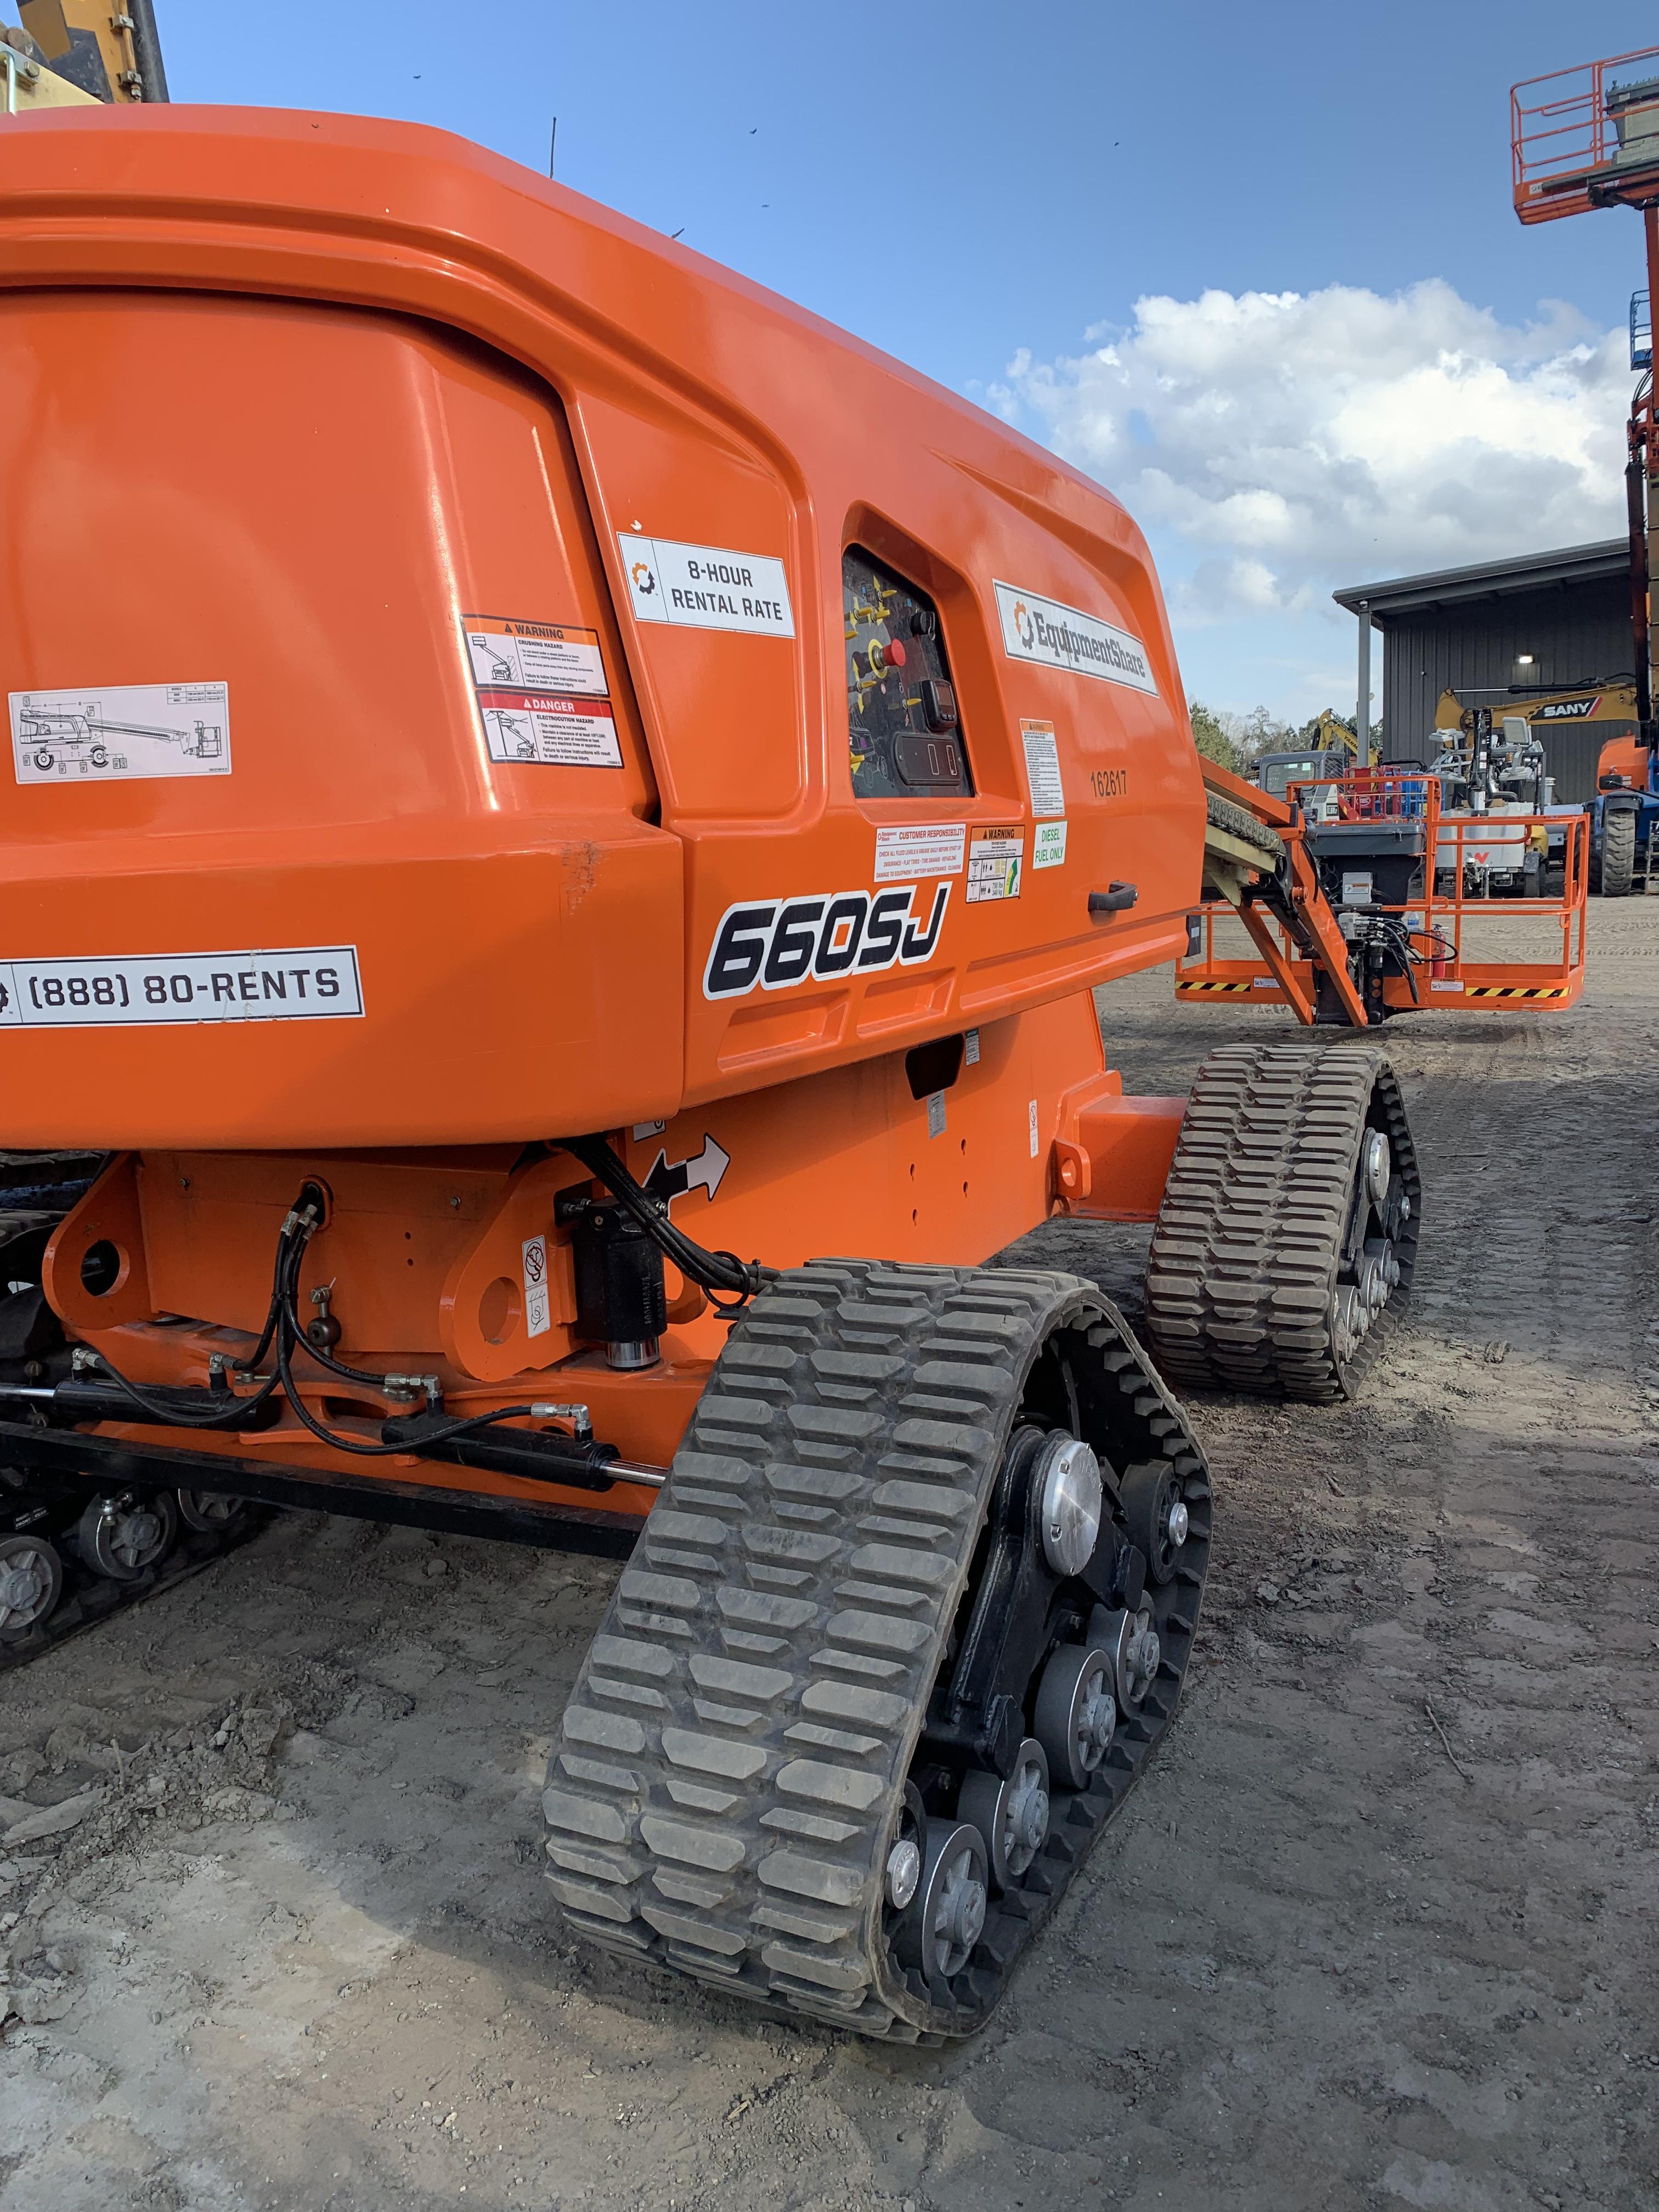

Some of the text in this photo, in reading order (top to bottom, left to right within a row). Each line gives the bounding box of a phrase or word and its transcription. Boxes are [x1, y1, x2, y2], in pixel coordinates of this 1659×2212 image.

[687, 560, 753, 587] 8-HOUR
[671, 588, 783, 620] RENTAL RATE
[515, 624, 564, 639] WARNING
[1032, 611, 1146, 678] EquipmentShare
[532, 699, 575, 712] DANGER
[1543, 702, 1591, 718] SANY
[1091, 770, 1126, 798] 162617
[899, 828, 964, 839] CUSTOMER RESPONSIBILITY
[989, 829, 1014, 839] WARNING
[1041, 828, 1060, 842] DIESEL
[1035, 847, 1064, 862] FUEL ONLY
[706, 884, 950, 996] 660SJ
[29, 968, 340, 1009] (888) 80-RENTS
